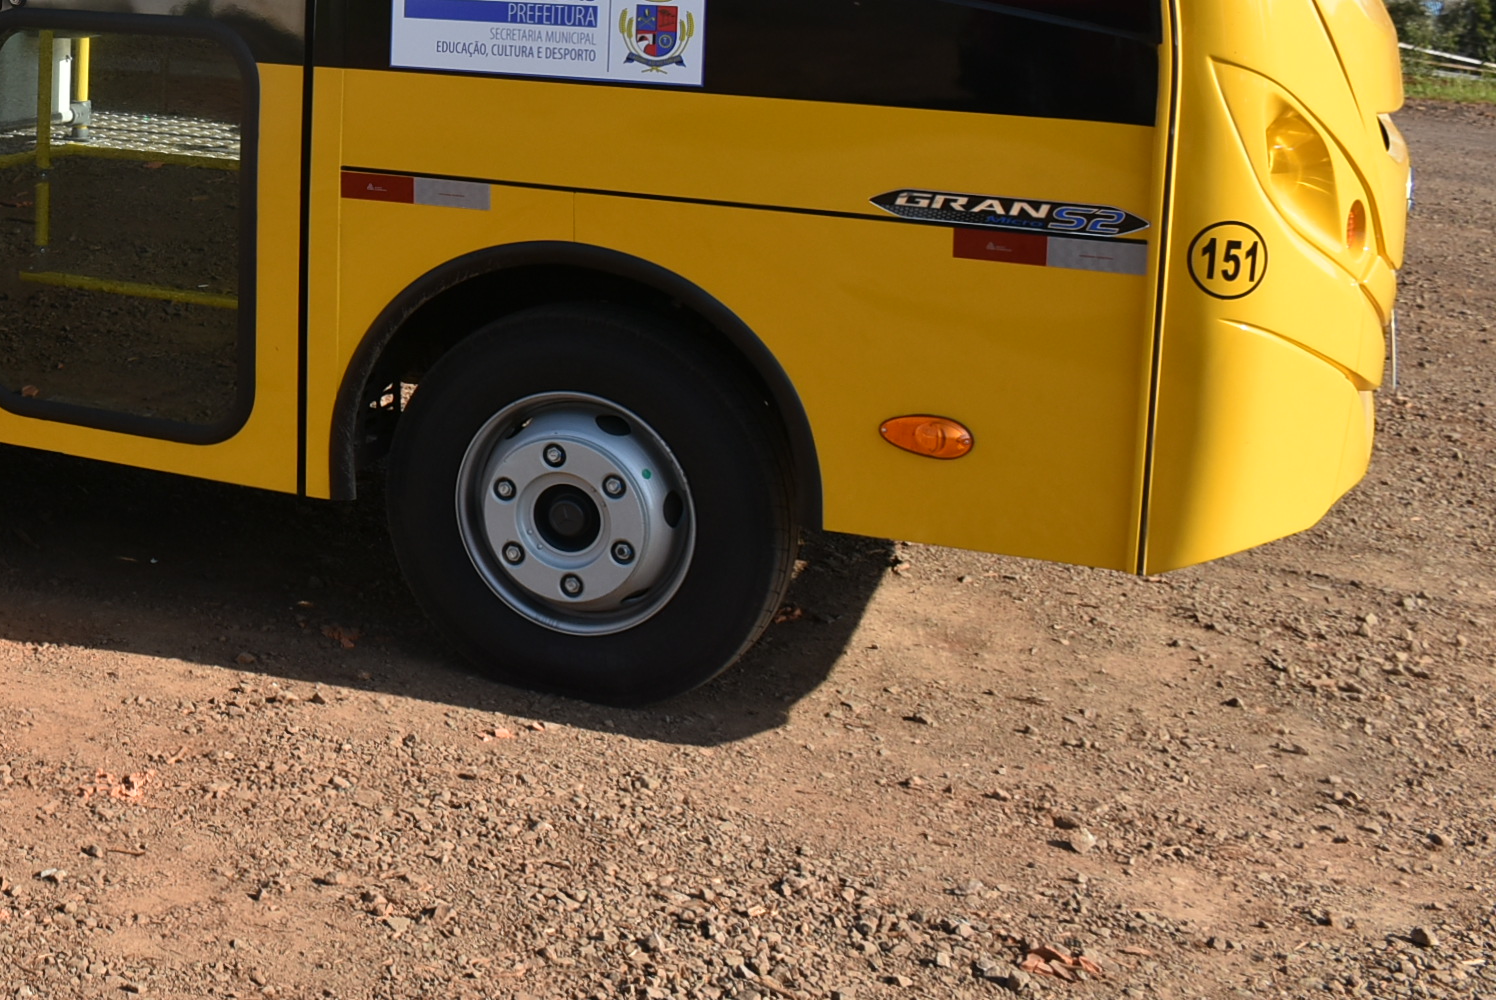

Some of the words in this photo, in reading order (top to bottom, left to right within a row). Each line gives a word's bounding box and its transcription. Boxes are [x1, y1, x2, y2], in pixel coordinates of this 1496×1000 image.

[508, 3, 596, 26] PREFEITURA
[489, 27, 543, 42] SECRETARIA
[544, 30, 597, 46] MUNICIPAL
[436, 40, 489, 58] EDUCAÇÃO,
[491, 43, 534, 58] CULTURA
[537, 46, 543, 59] E
[545, 47, 596, 62] DESPORTO
[894, 191, 1051, 219] GRAN
[1047, 206, 1126, 233] S2
[985, 214, 1046, 228] Micro
[1201, 237, 1259, 283] 151
